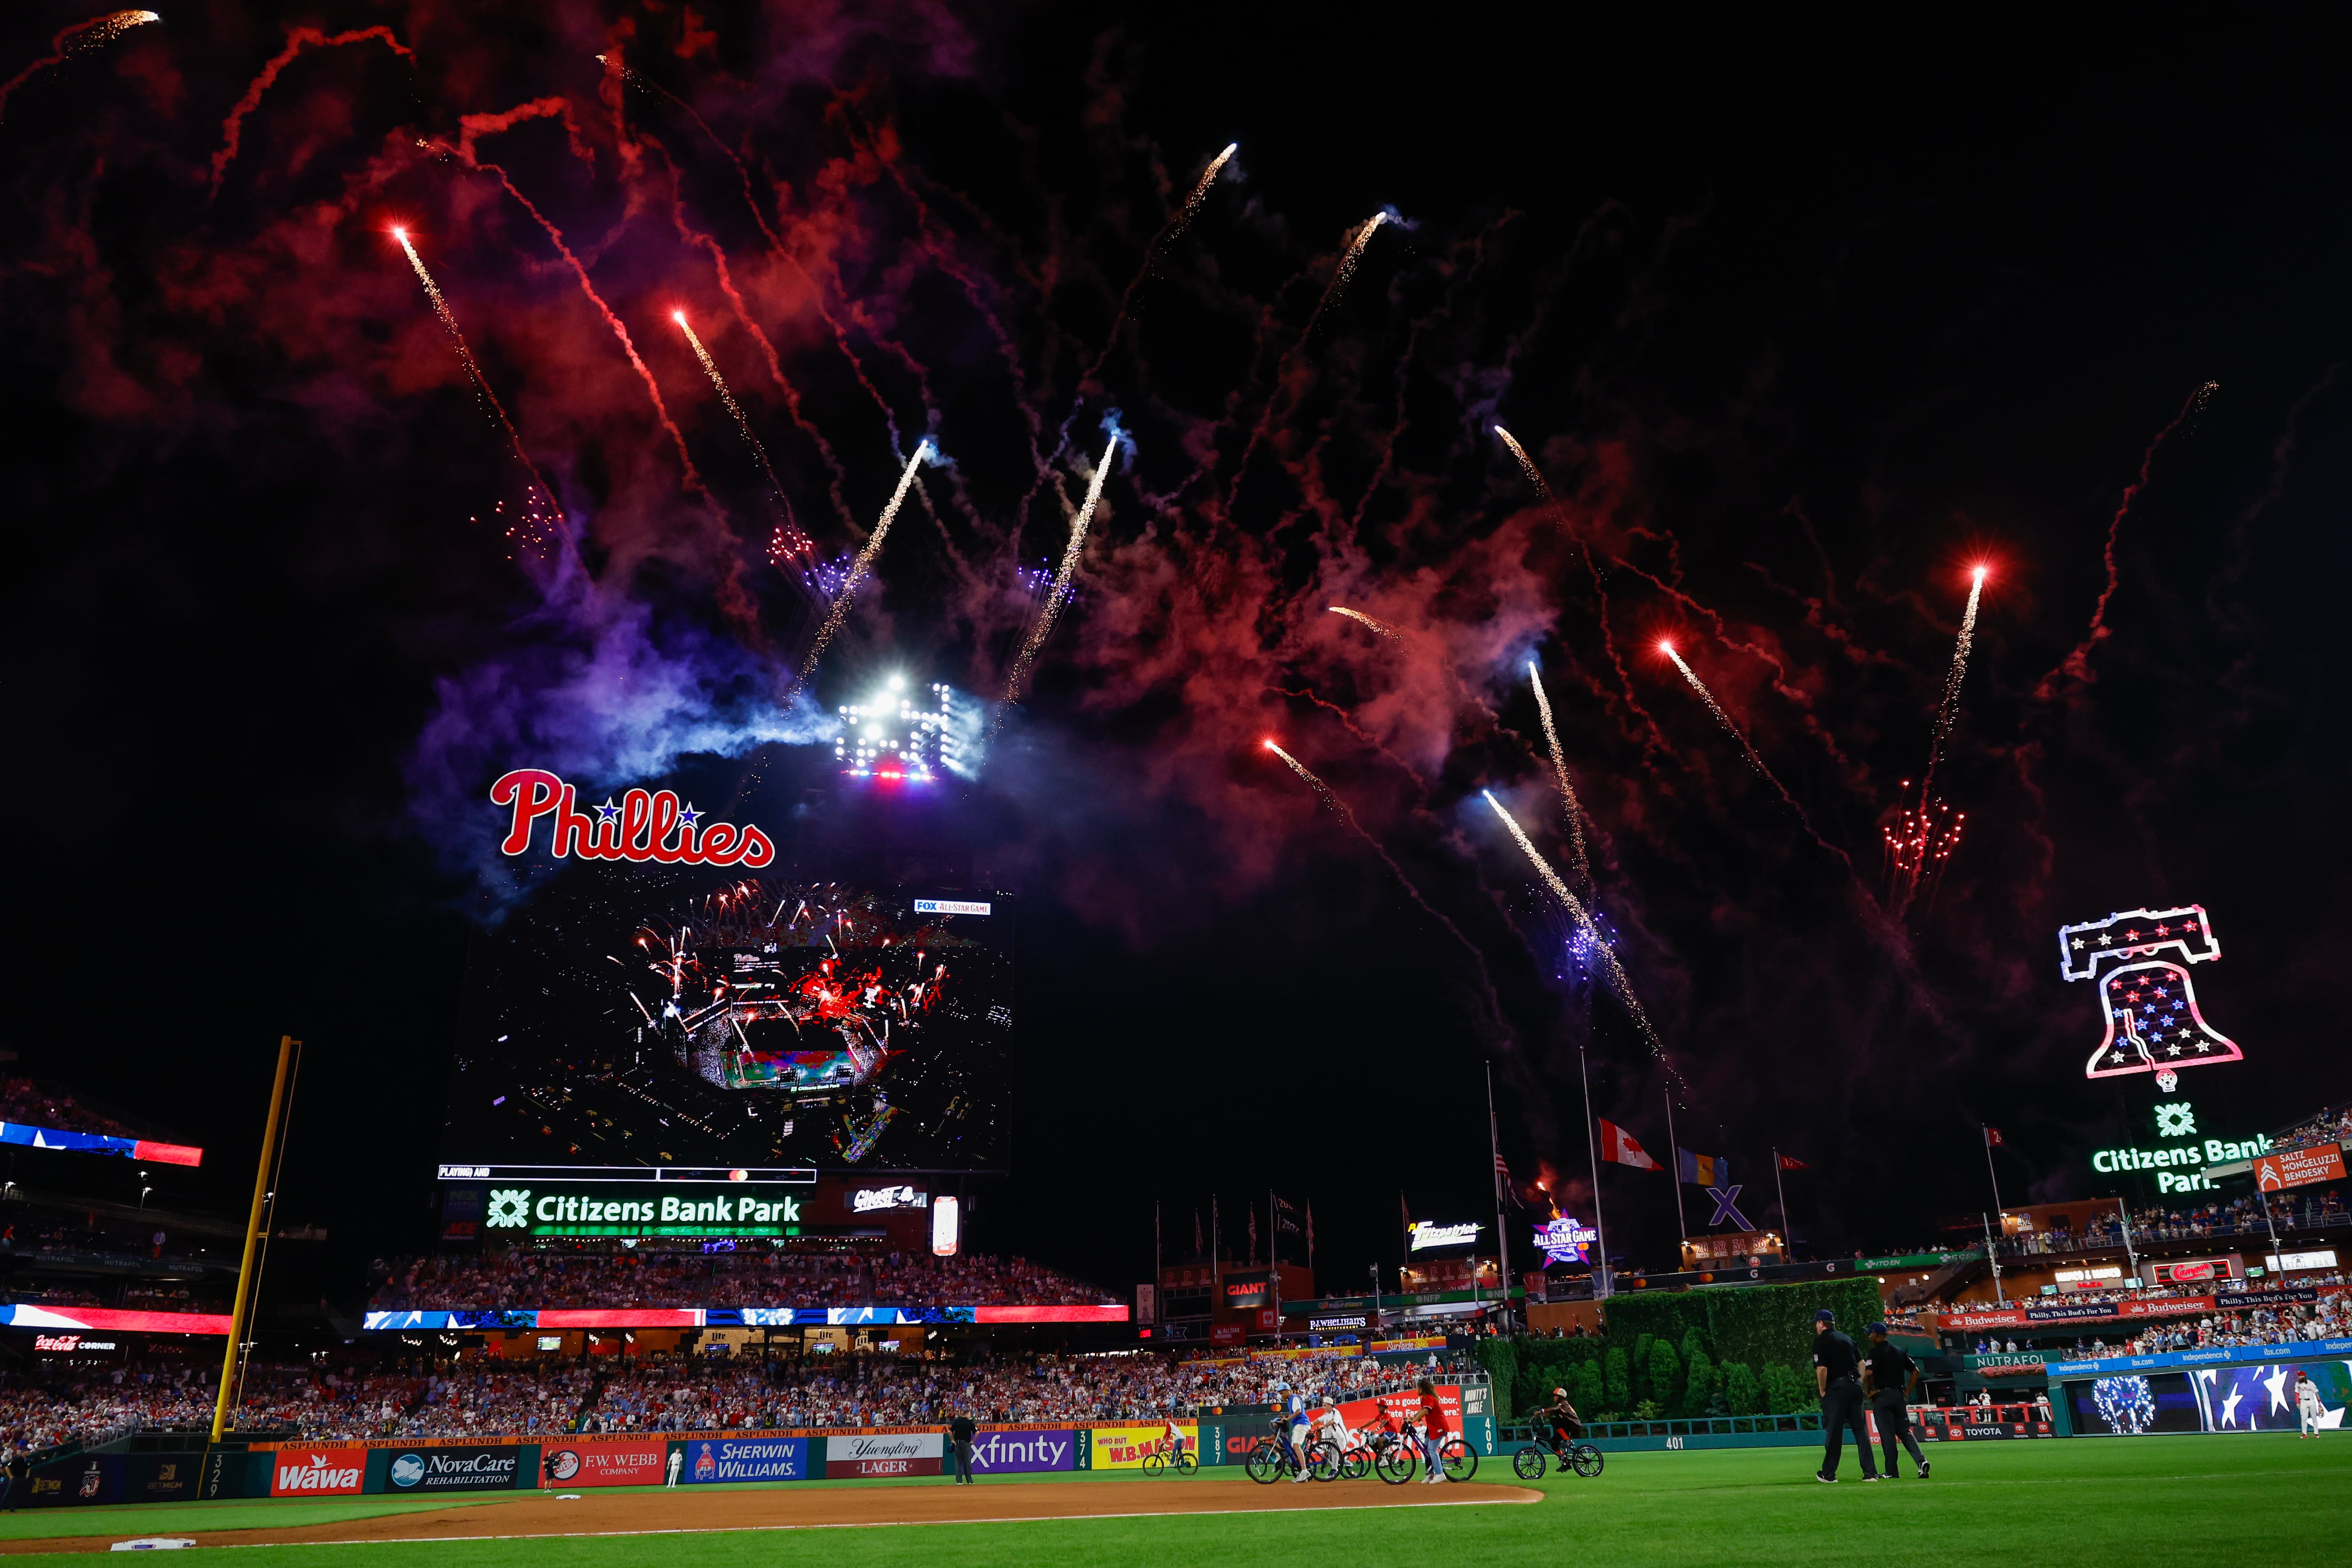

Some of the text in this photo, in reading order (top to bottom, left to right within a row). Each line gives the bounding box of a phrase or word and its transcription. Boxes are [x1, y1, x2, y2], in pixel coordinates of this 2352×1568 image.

[490, 769, 775, 868] Phillies
[917, 902, 937, 911] FOX
[970, 904, 988, 913] GAME
[2093, 1133, 2274, 1173] Citizens Bank
[2280, 1150, 2306, 1163] SALTZ
[2281, 1154, 2339, 1172] MONGELUZZI
[473, 1167, 490, 1177] AND
[2284, 1165, 2329, 1182] BENDESKY
[853, 1186, 903, 1213] GHOST
[536, 1195, 800, 1222] Citizens Bank Park
[2017, 1213, 2032, 1227] 42
[1533, 1230, 1597, 1246] ALL STAR GAME
[1752, 1236, 1766, 1250] 36
[1695, 1242, 1708, 1254] 20
[1713, 1240, 1726, 1252] 32
[1732, 1239, 1746, 1251] 34
[1227, 1282, 1267, 1296] GIANT
[1422, 1294, 1440, 1302] NFP
[2146, 1301, 2202, 1313] Budweiser
[1964, 1315, 2015, 1326] Budweiser
[78, 1342, 116, 1350] CORNER
[1387, 1341, 1414, 1352] Surfside
[2264, 1347, 2290, 1356] ibx.com
[1311, 1350, 1339, 1360] Surfside
[1977, 1354, 2048, 1367] NUTRAFOL
[2183, 1352, 2223, 1362] Independence
[2058, 1362, 2093, 1372] Independence
[2131, 1358, 2154, 1367] ibx.com
[1464, 1387, 1487, 1402] MONTY'S
[1402, 1397, 1421, 1407] good
[1467, 1401, 1483, 1415] ANGLE
[874, 1426, 930, 1435] ASPLUNDH
[1007, 1423, 1062, 1431] ASPLUNDH
[1073, 1421, 1126, 1429] ASPLUNDH
[590, 1433, 651, 1442] ASPLUNDH
[663, 1432, 723, 1441] ASPLUNDH
[735, 1430, 793, 1439] ASPLUNDH
[805, 1428, 862, 1437] ASPLUNDH
[1965, 1427, 2002, 1436] TOYOTA
[282, 1441, 348, 1450] ASPLUNDH
[360, 1439, 426, 1449] ASPLUNDH
[439, 1437, 503, 1446] ASPLUNDH
[515, 1435, 578, 1444] ASPLUNDH
[1097, 1436, 1128, 1446] WHO BUT
[1666, 1437, 1684, 1449] 401
[721, 1443, 795, 1460] SHERWIN
[848, 1438, 922, 1459] Yuengling
[971, 1434, 1067, 1468] xfinity
[426, 1454, 513, 1474] NovaCare
[585, 1454, 658, 1468] F.W. WEBB
[600, 1467, 640, 1476] COMPANY
[718, 1461, 792, 1478] WILLIAMS
[861, 1461, 908, 1474] LAGER
[210, 1455, 222, 1497] 329
[278, 1465, 359, 1490] Wawa
[425, 1475, 510, 1485] REHABILITATION
[39, 1478, 62, 1491] BETMGM
[148, 1481, 183, 1490] BETMGM
